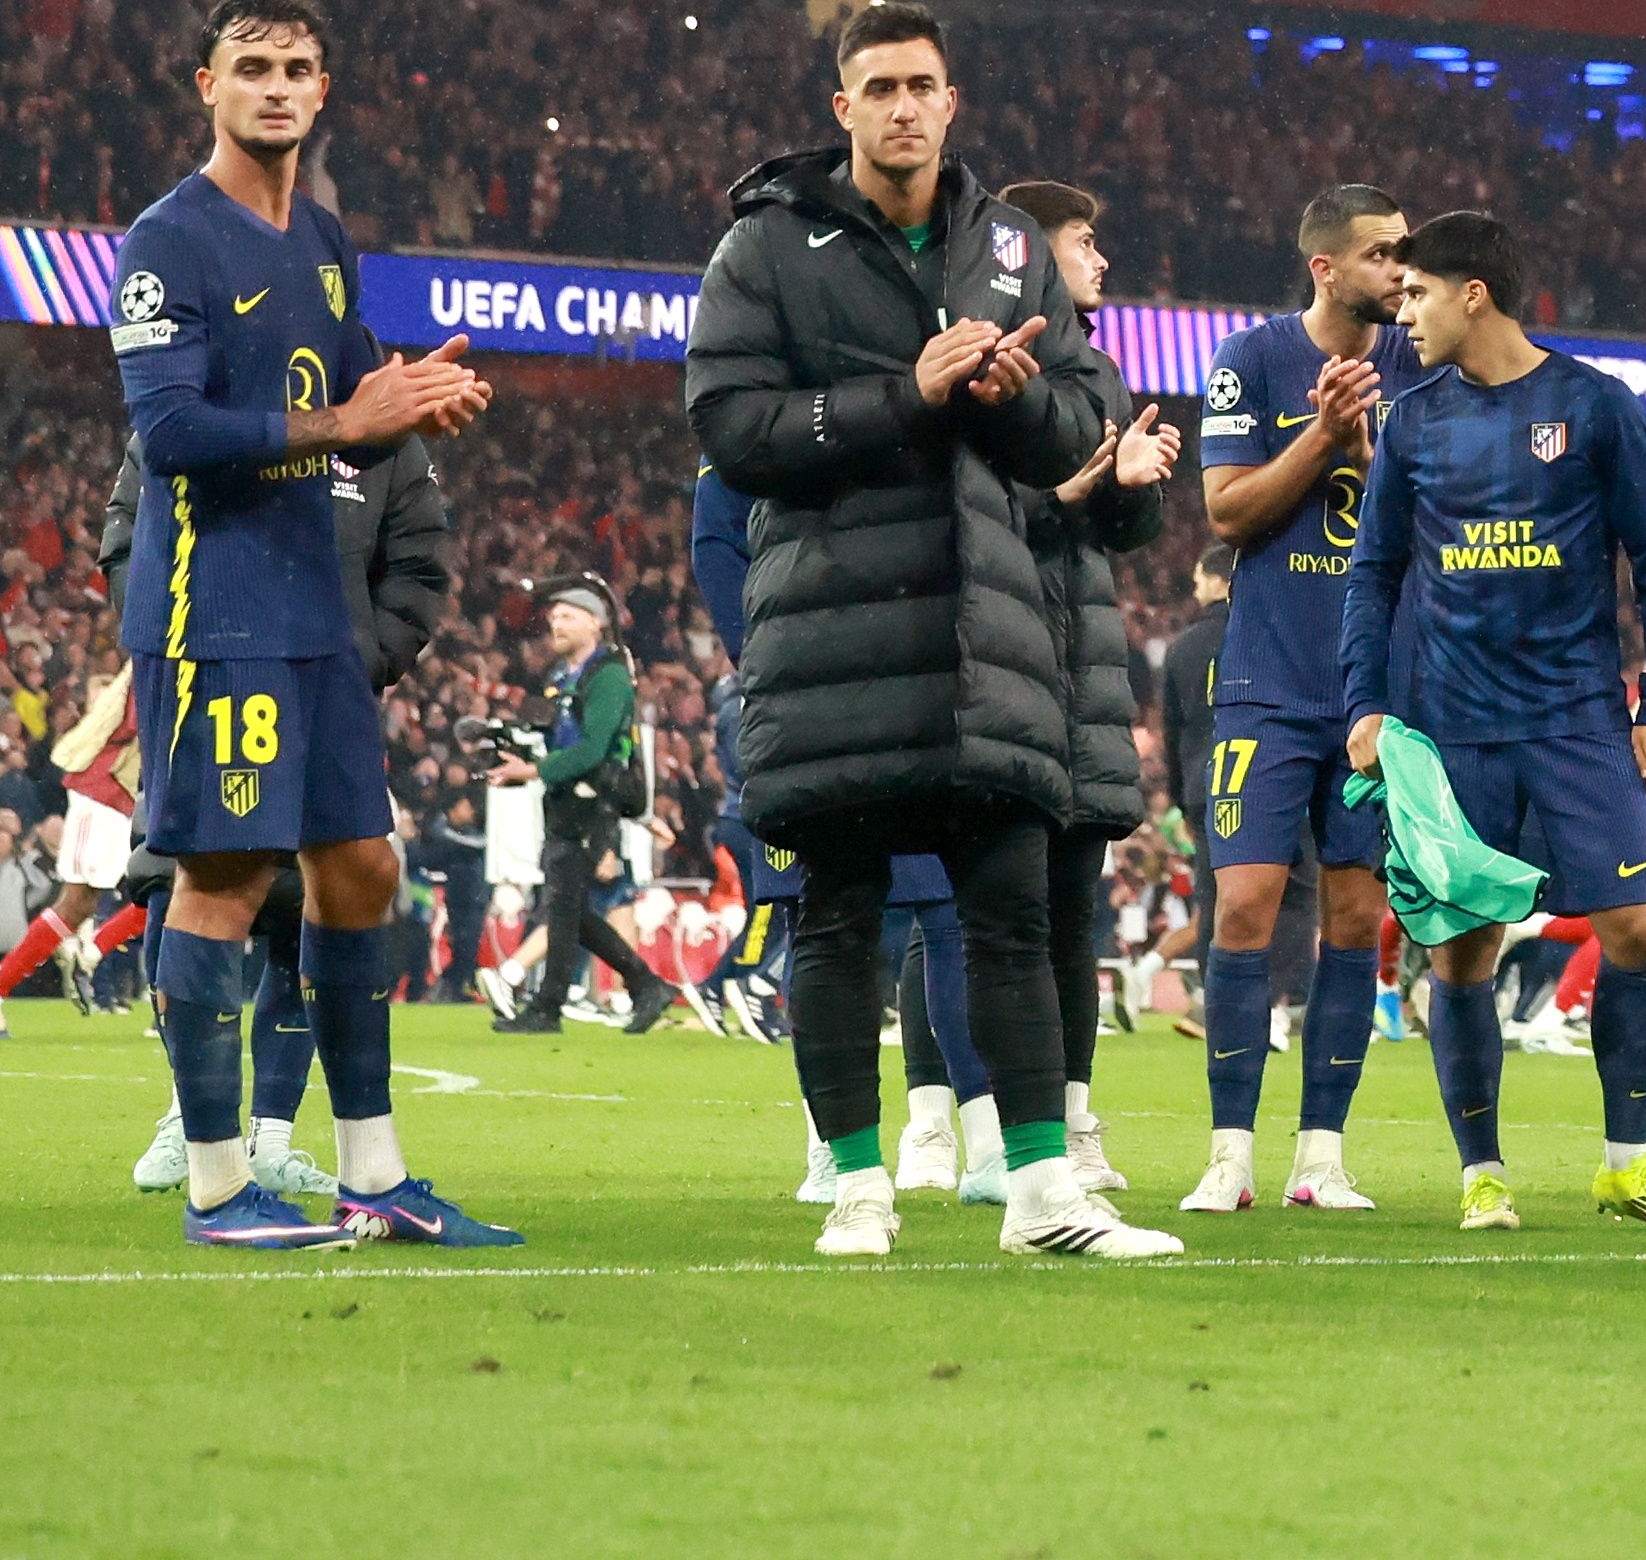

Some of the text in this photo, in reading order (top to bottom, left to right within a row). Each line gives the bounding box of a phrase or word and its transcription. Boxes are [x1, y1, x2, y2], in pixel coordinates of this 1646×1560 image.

[430, 277, 700, 341] UEFA CHAM
[330, 488, 366, 502] WANDA
[333, 481, 358, 492] VISIT
[1463, 520, 1536, 545] VISIT
[1442, 544, 1562, 572] RWANDA
[207, 693, 279, 765] 18
[1211, 739, 1259, 796] 17
